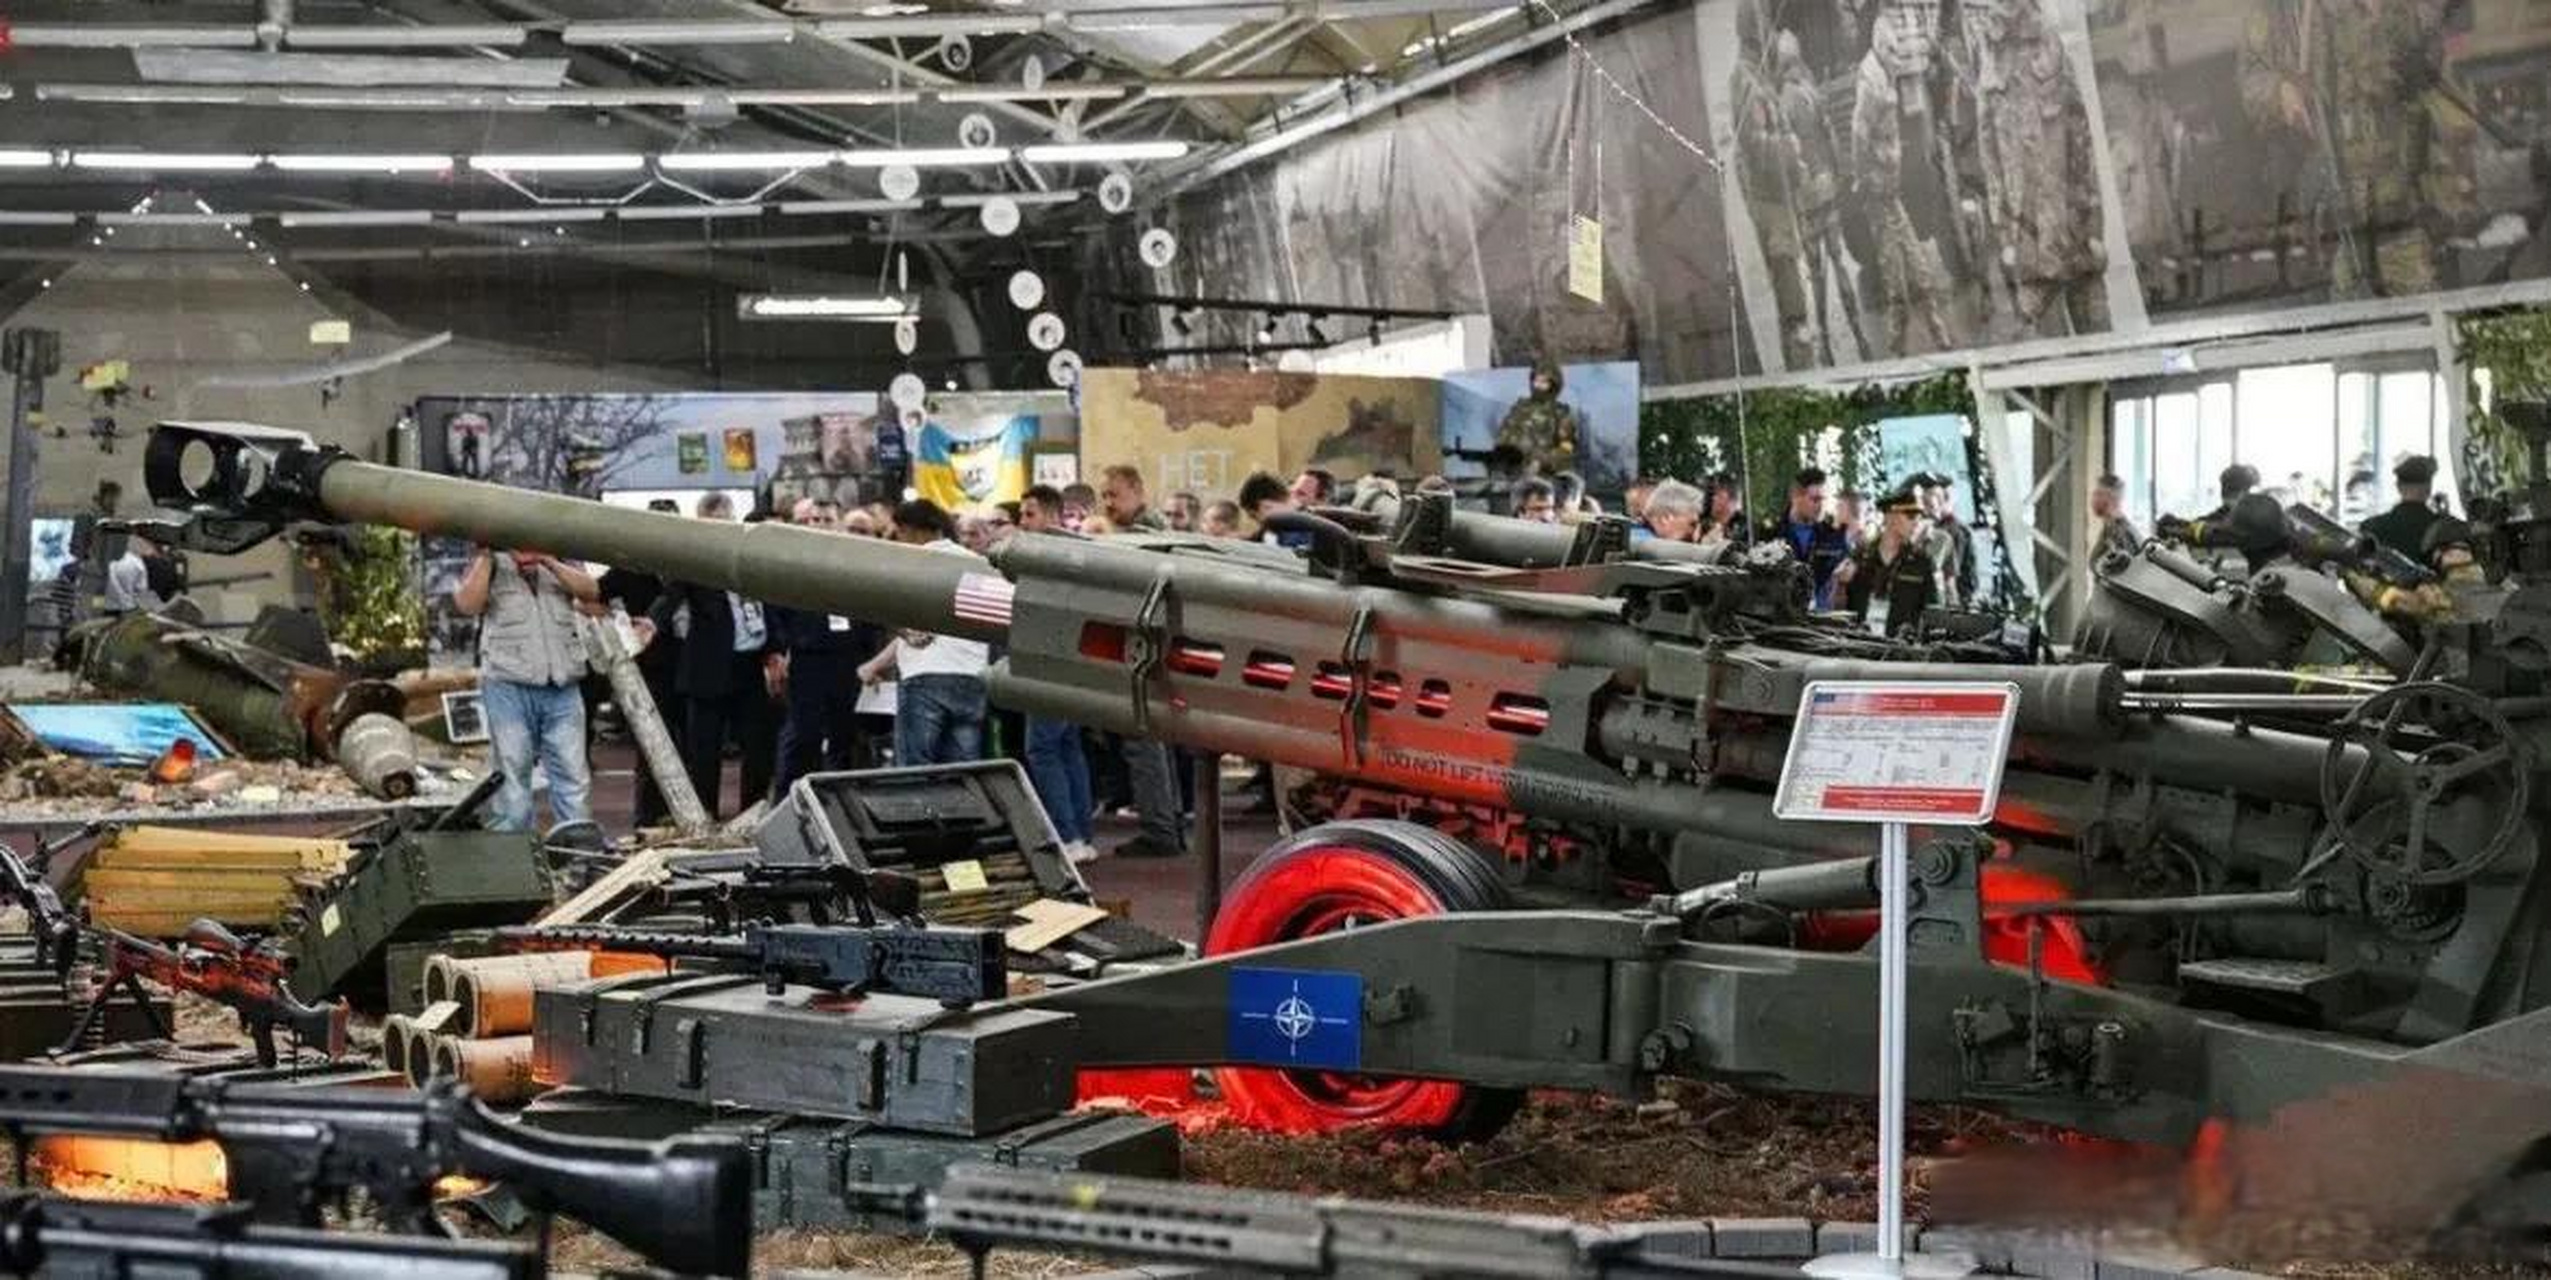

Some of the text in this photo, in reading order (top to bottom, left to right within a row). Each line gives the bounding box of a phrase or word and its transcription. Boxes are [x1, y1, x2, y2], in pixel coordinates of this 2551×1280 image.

[1160, 449, 1234, 489] НЕТ
[1385, 750, 1411, 769] DO
[1412, 755, 1448, 777] NOT
